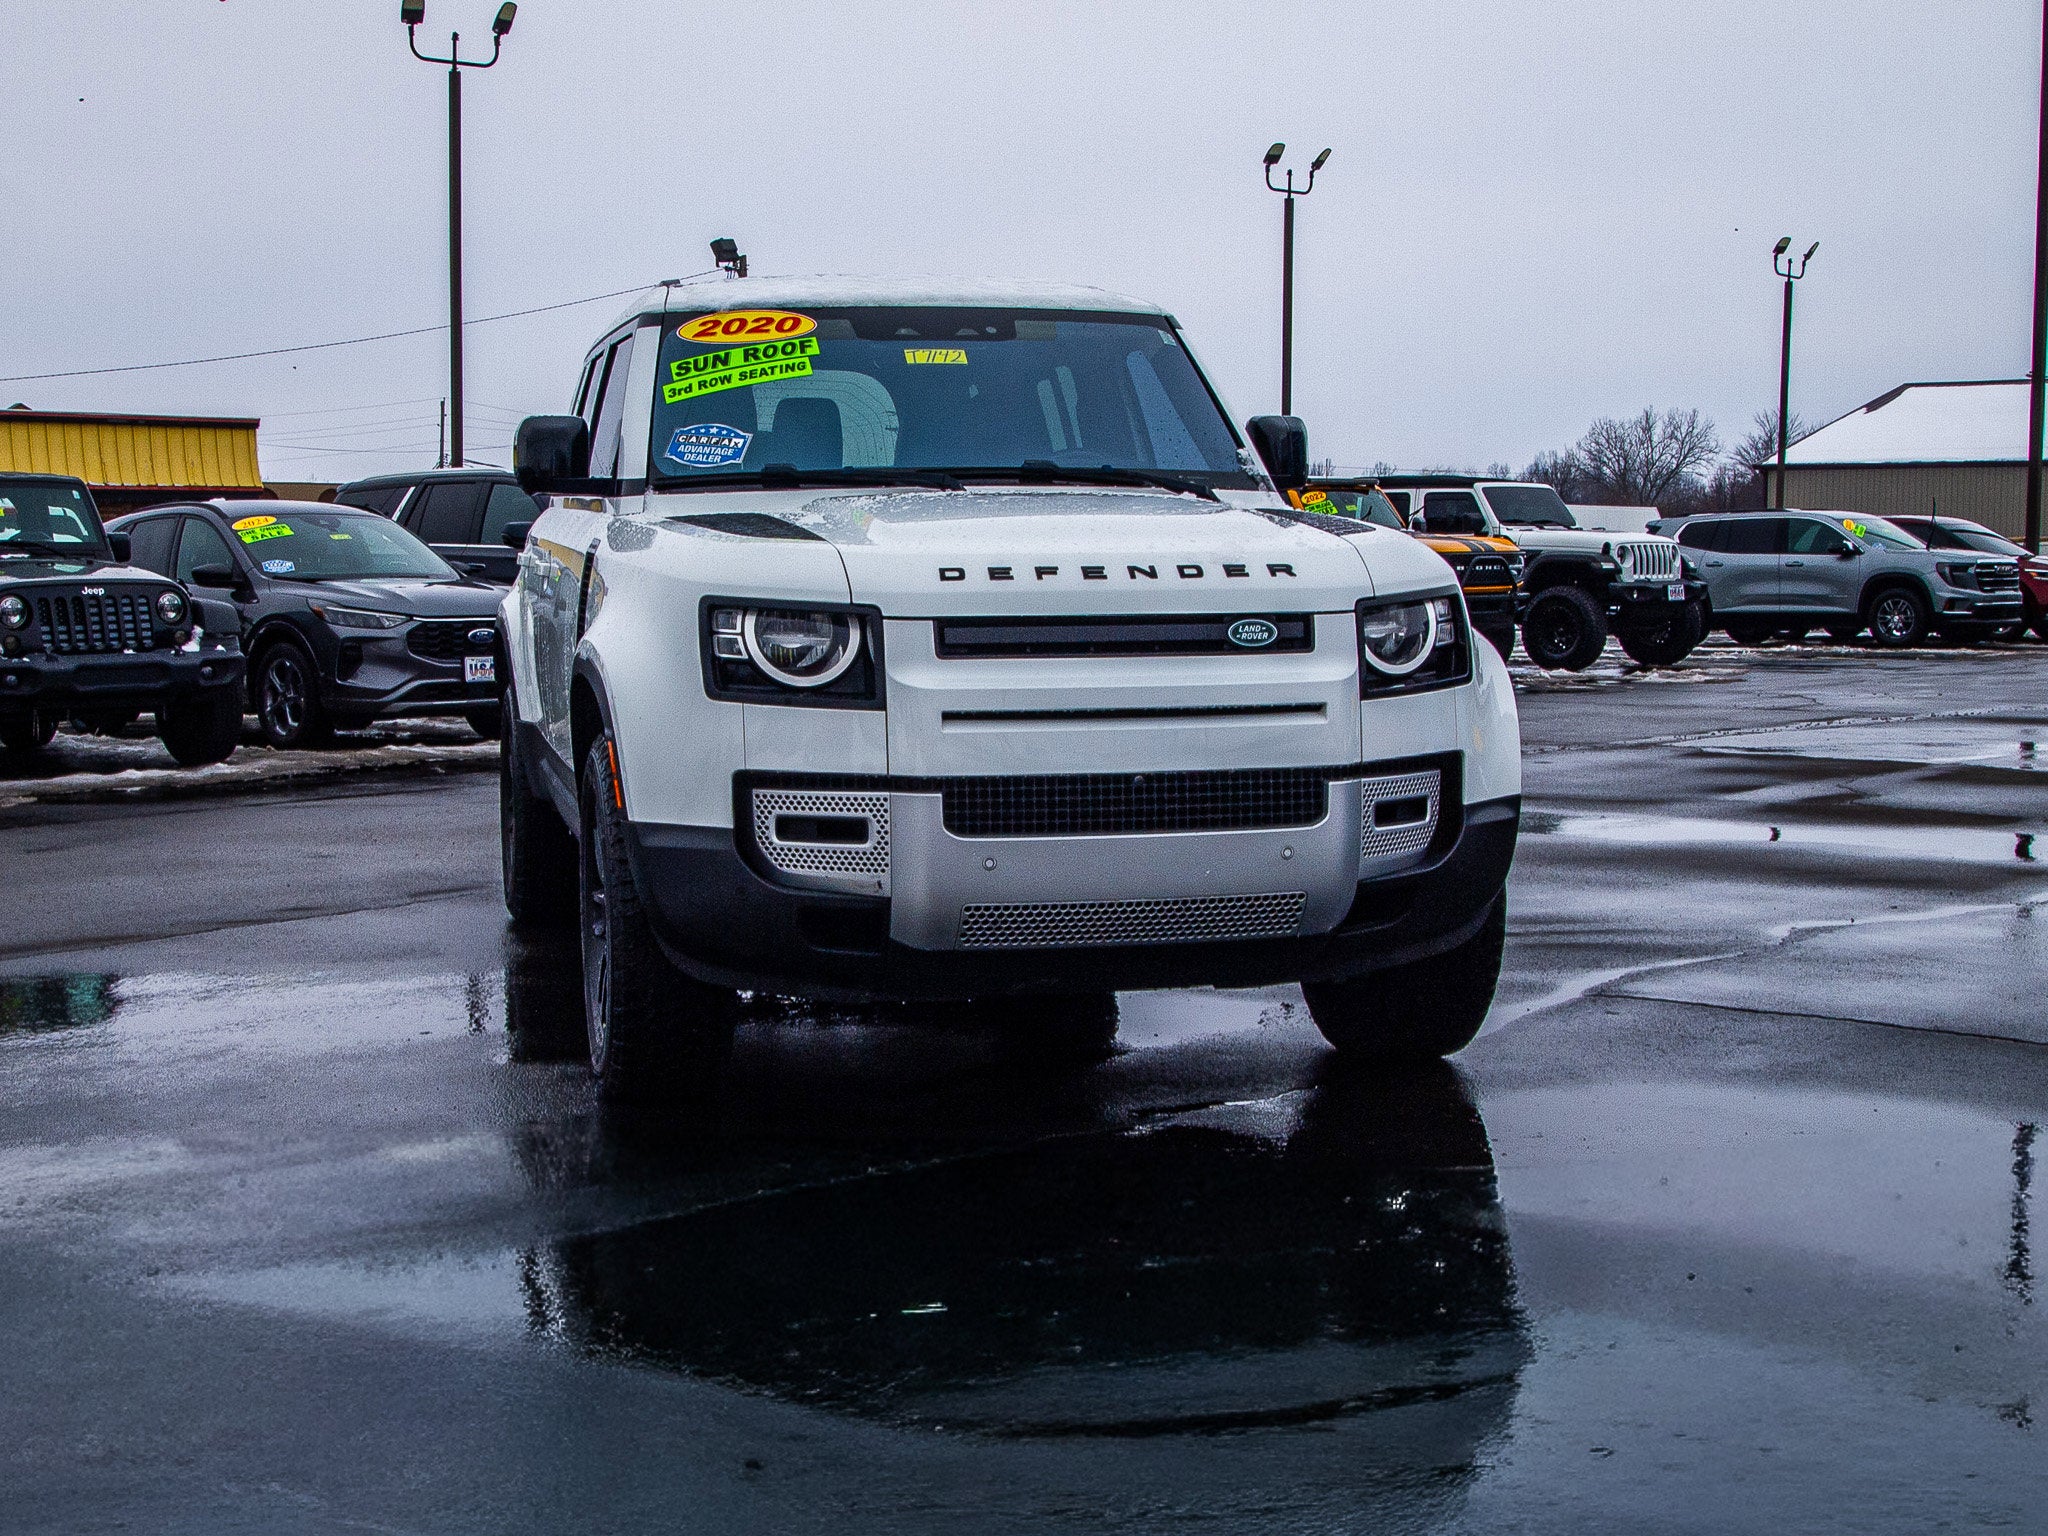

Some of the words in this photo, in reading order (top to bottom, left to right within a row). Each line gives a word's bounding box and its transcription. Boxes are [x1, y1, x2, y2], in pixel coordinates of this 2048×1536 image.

[692, 316, 802, 338] 2020
[674, 352, 731, 377] SUN
[743, 340, 813, 362] ROOF
[667, 383, 693, 398] 3rd
[697, 374, 733, 390] ROW
[738, 361, 806, 381] SEATING
[676, 434, 744, 448] CARFAX
[677, 444, 735, 456] ADVANTAGE
[683, 452, 722, 463] DEALER
[1304, 492, 1325, 503] 2022
[938, 564, 1297, 581] DEFENDER
[81, 586, 105, 596] Jeep
